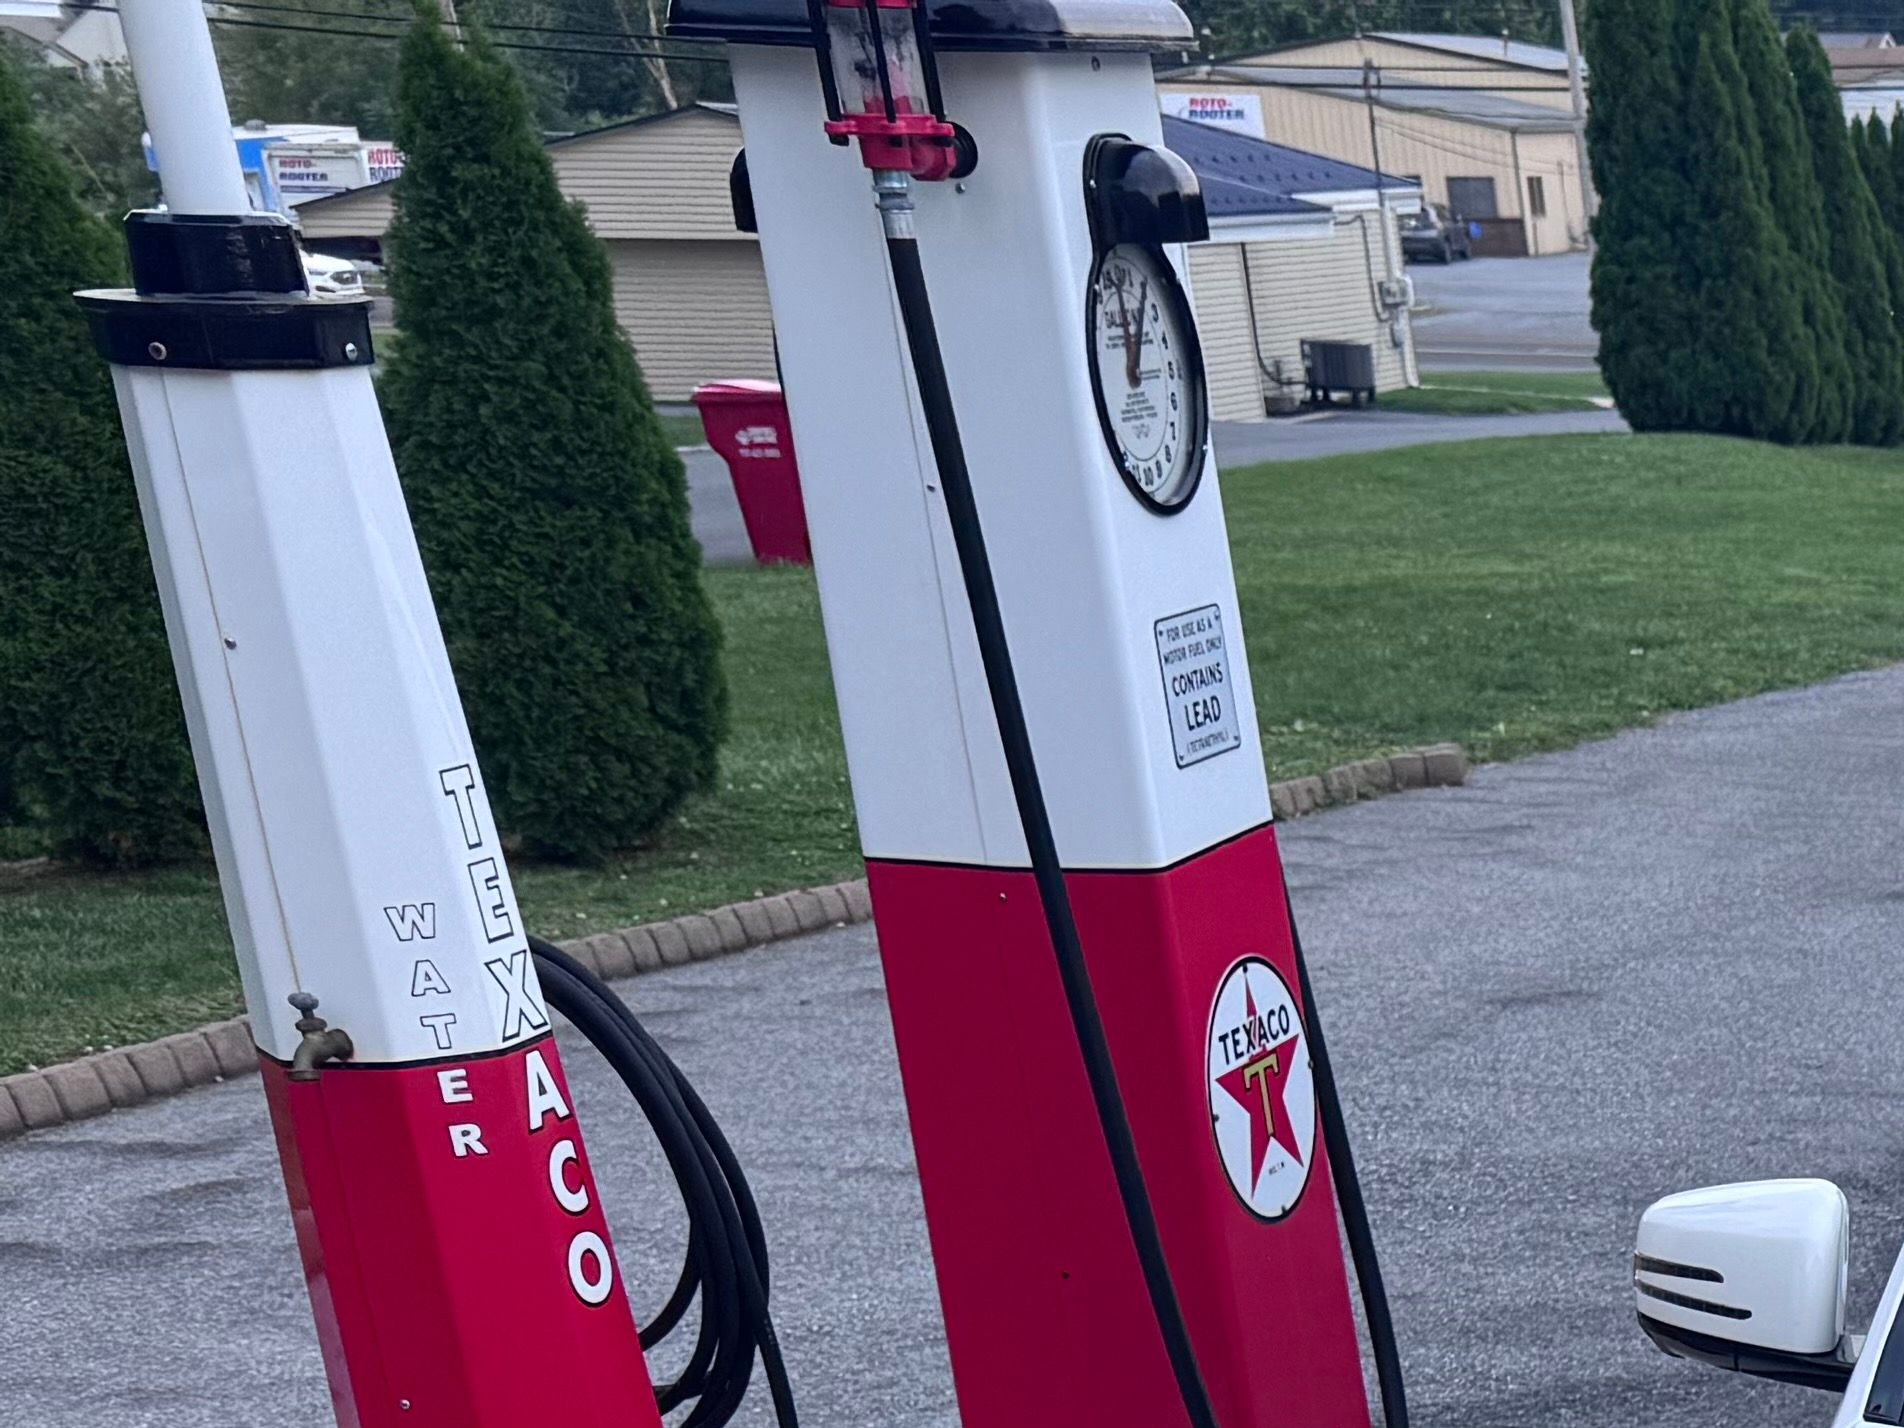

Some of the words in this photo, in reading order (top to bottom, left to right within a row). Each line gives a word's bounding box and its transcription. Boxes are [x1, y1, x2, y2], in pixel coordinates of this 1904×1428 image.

[1150, 302, 1159, 323] 3
[1168, 360, 1175, 380] 5
[1170, 391, 1178, 412] 6
[1172, 661, 1224, 698] CONTAINS
[1184, 695, 1222, 732] LEAD
[383, 902, 488, 1158] WATER
[440, 763, 613, 1307] TEXACO
[1218, 1003, 1291, 1066] TEXACO
[1243, 1050, 1280, 1137] T
